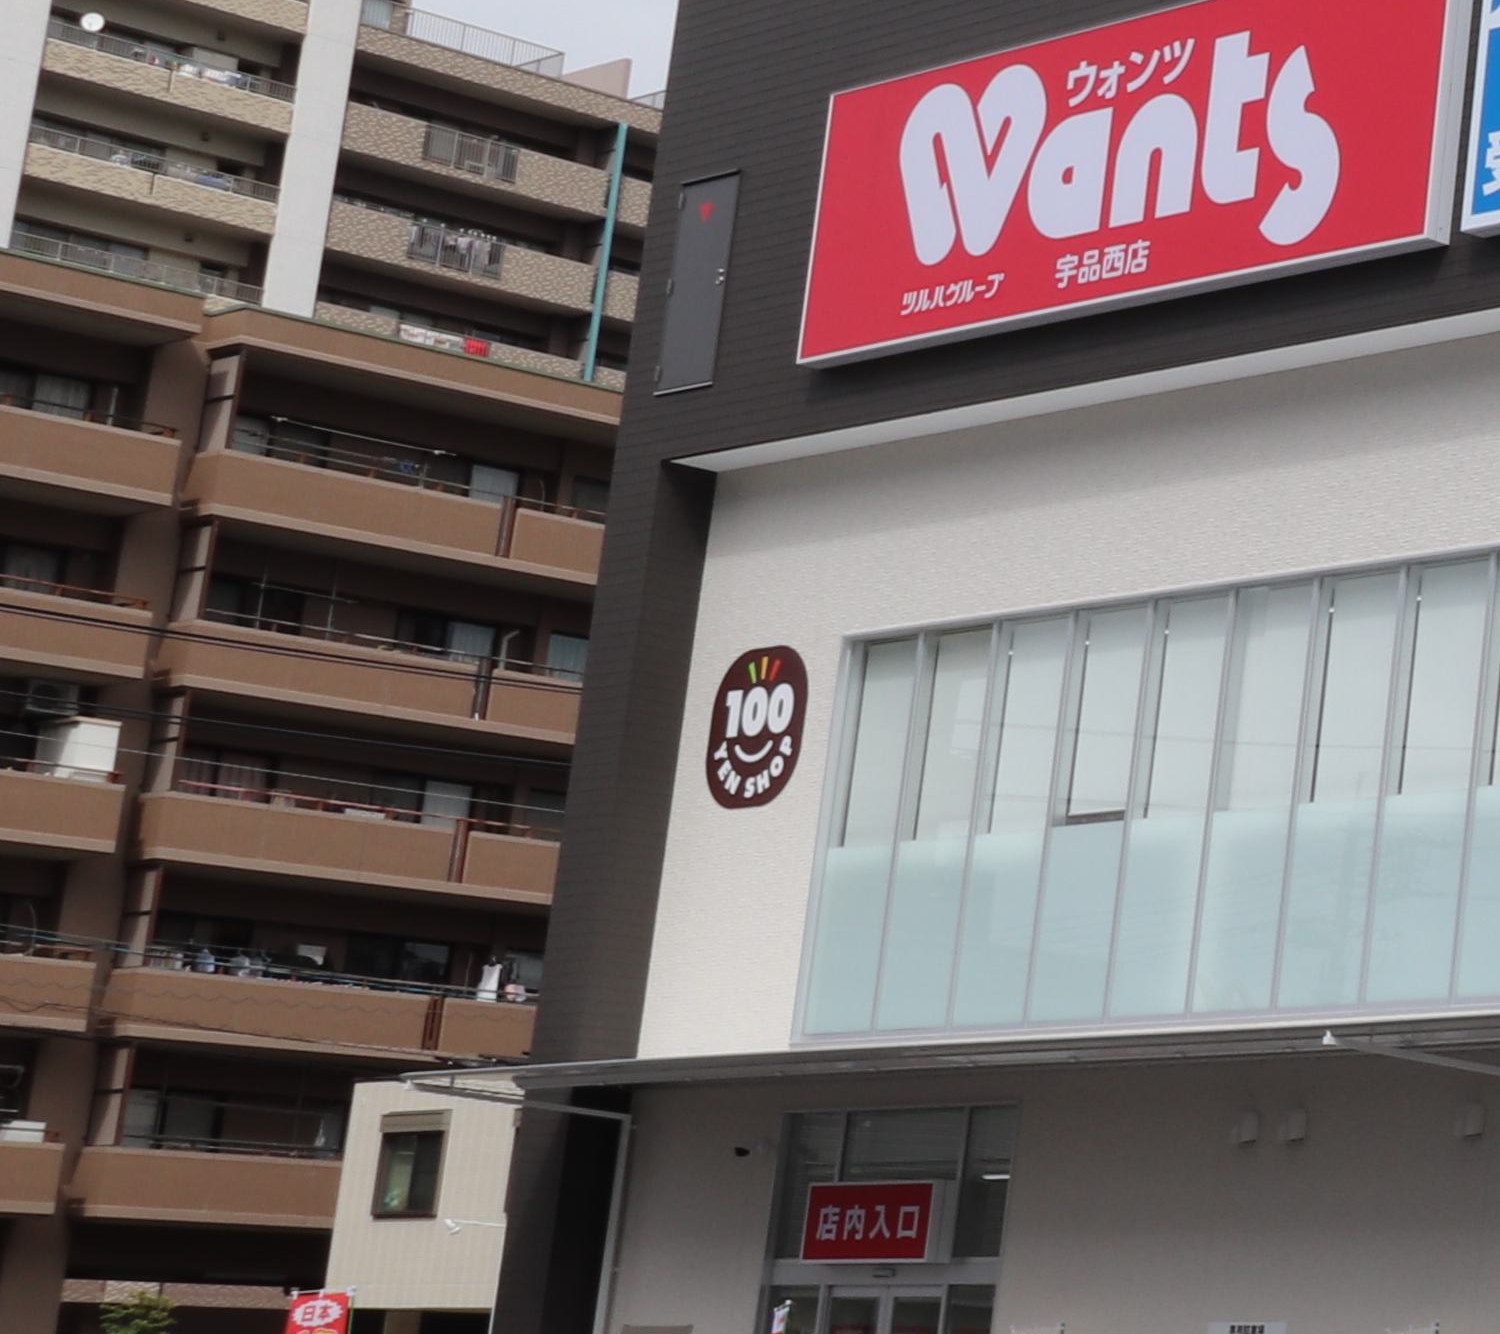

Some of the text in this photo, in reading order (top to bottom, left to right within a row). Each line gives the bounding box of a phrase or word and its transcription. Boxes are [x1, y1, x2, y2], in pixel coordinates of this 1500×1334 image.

[1066, 38, 1196, 107] ウォンツ
[899, 30, 1340, 266] Wants
[1054, 239, 1150, 290] 宇品西店
[901, 271, 1005, 316] ツルハグループ
[725, 682, 795, 739] 100
[714, 735, 793, 799] YEN SHOP
[816, 1204, 921, 1241] 店内入口
